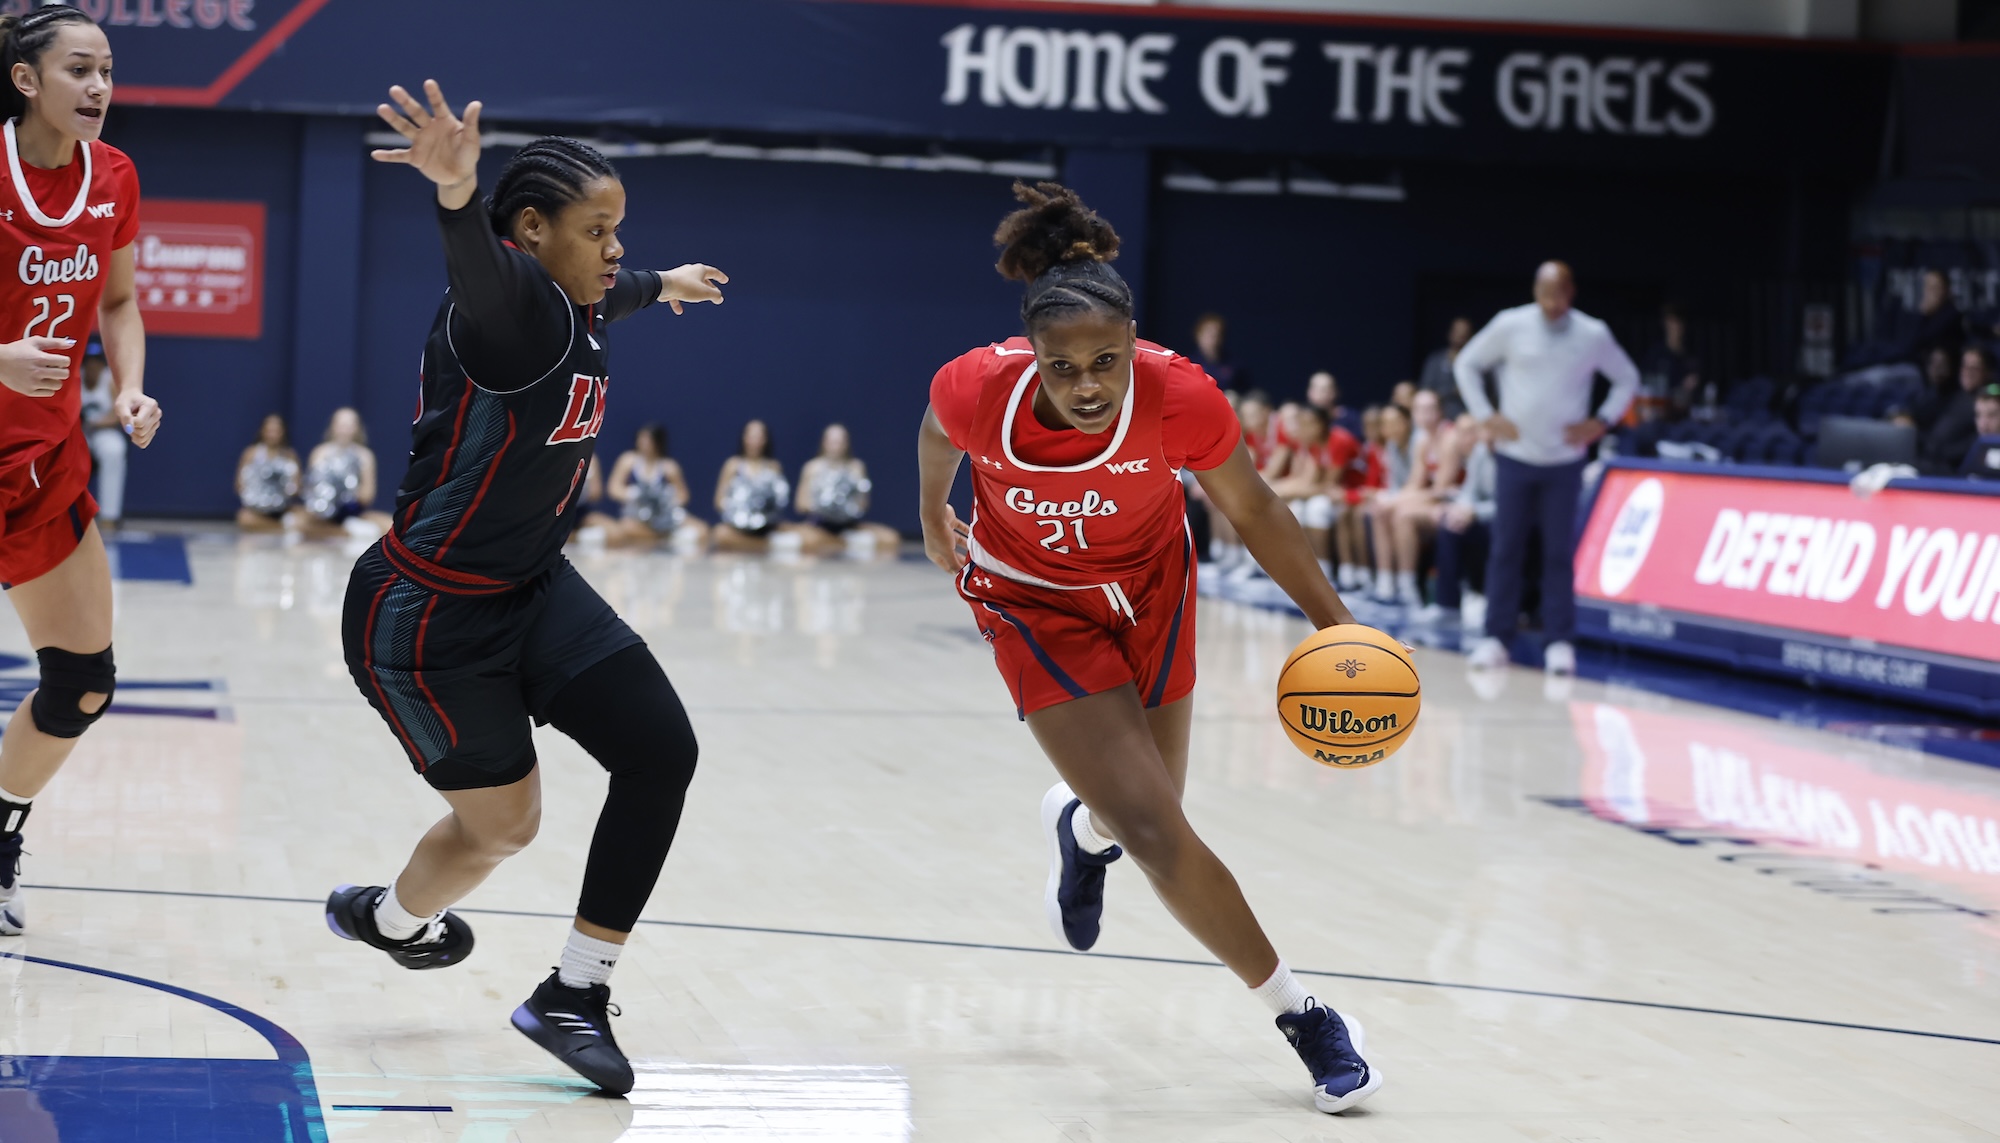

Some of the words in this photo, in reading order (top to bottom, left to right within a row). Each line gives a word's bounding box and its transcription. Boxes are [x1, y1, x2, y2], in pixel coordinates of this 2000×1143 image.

[76, 0, 257, 31] OLLEGE
[941, 24, 1176, 114] HOME
[1199, 37, 1294, 117] OF
[1323, 43, 1471, 126] THE
[1496, 53, 1715, 136] GAELS
[18, 244, 99, 285] Gaels
[23, 294, 75, 338] 22
[1104, 458, 1150, 475] WCC
[1005, 487, 1118, 517] Gaels
[1036, 518, 1089, 554] 21
[1694, 508, 1877, 603] DEFEND
[1300, 703, 1398, 734] Wilson
[1314, 749, 1385, 766] NCAA
